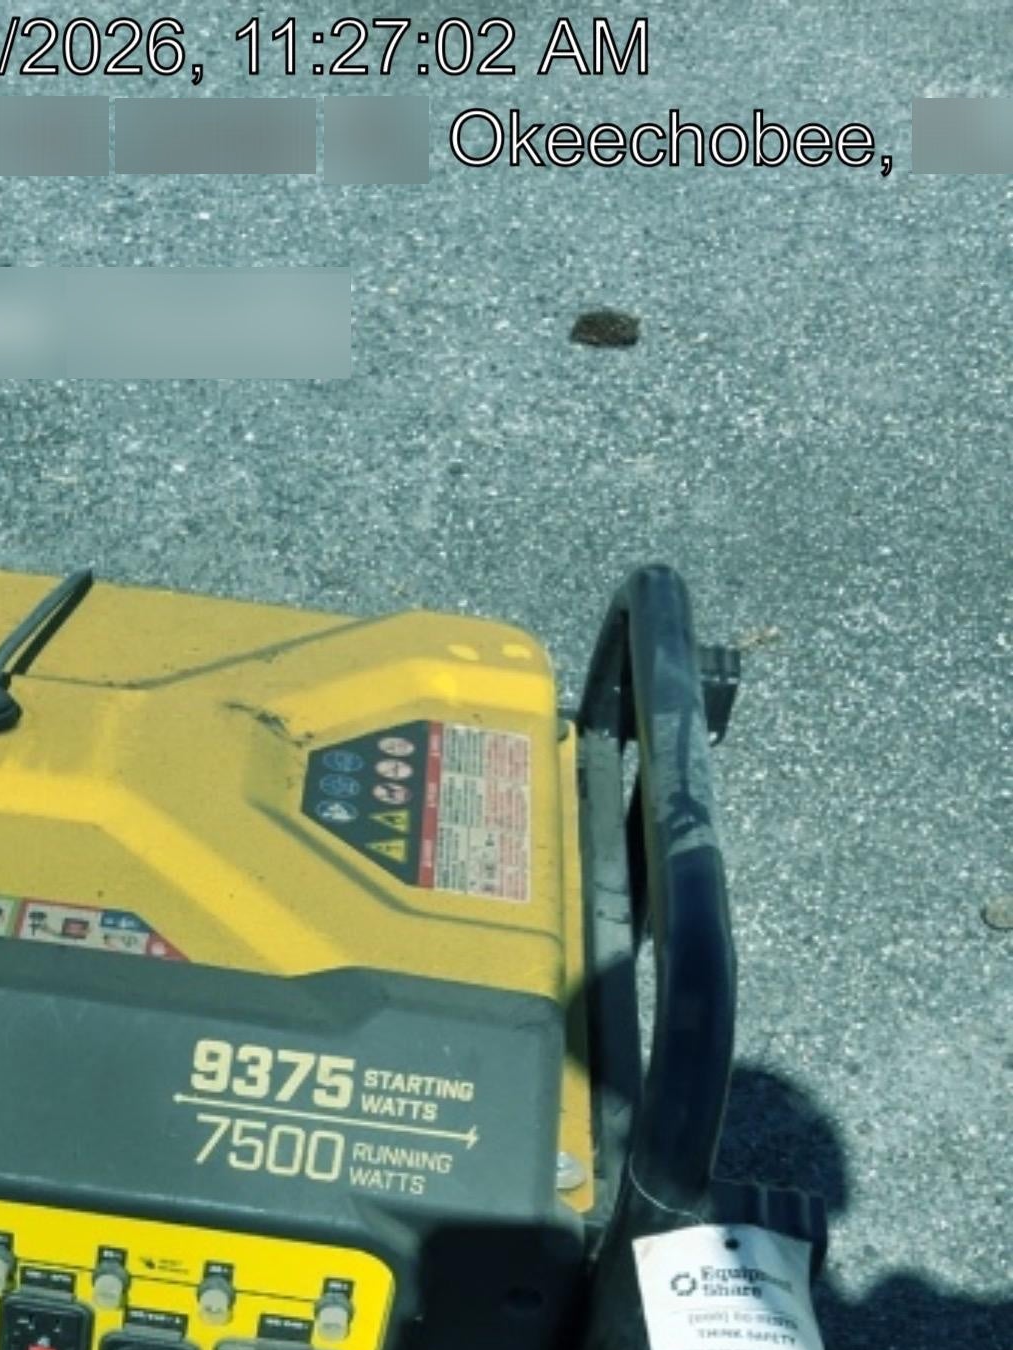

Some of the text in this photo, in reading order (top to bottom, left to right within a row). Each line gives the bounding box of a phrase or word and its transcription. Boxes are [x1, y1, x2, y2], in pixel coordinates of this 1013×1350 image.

[190, 1038, 356, 1110] 9375
[363, 1069, 475, 1102] STARTING
[361, 1095, 438, 1121] WATTS
[194, 1113, 345, 1182] 7500
[352, 1142, 454, 1175] RUNNING
[349, 1167, 427, 1195] WATTS
